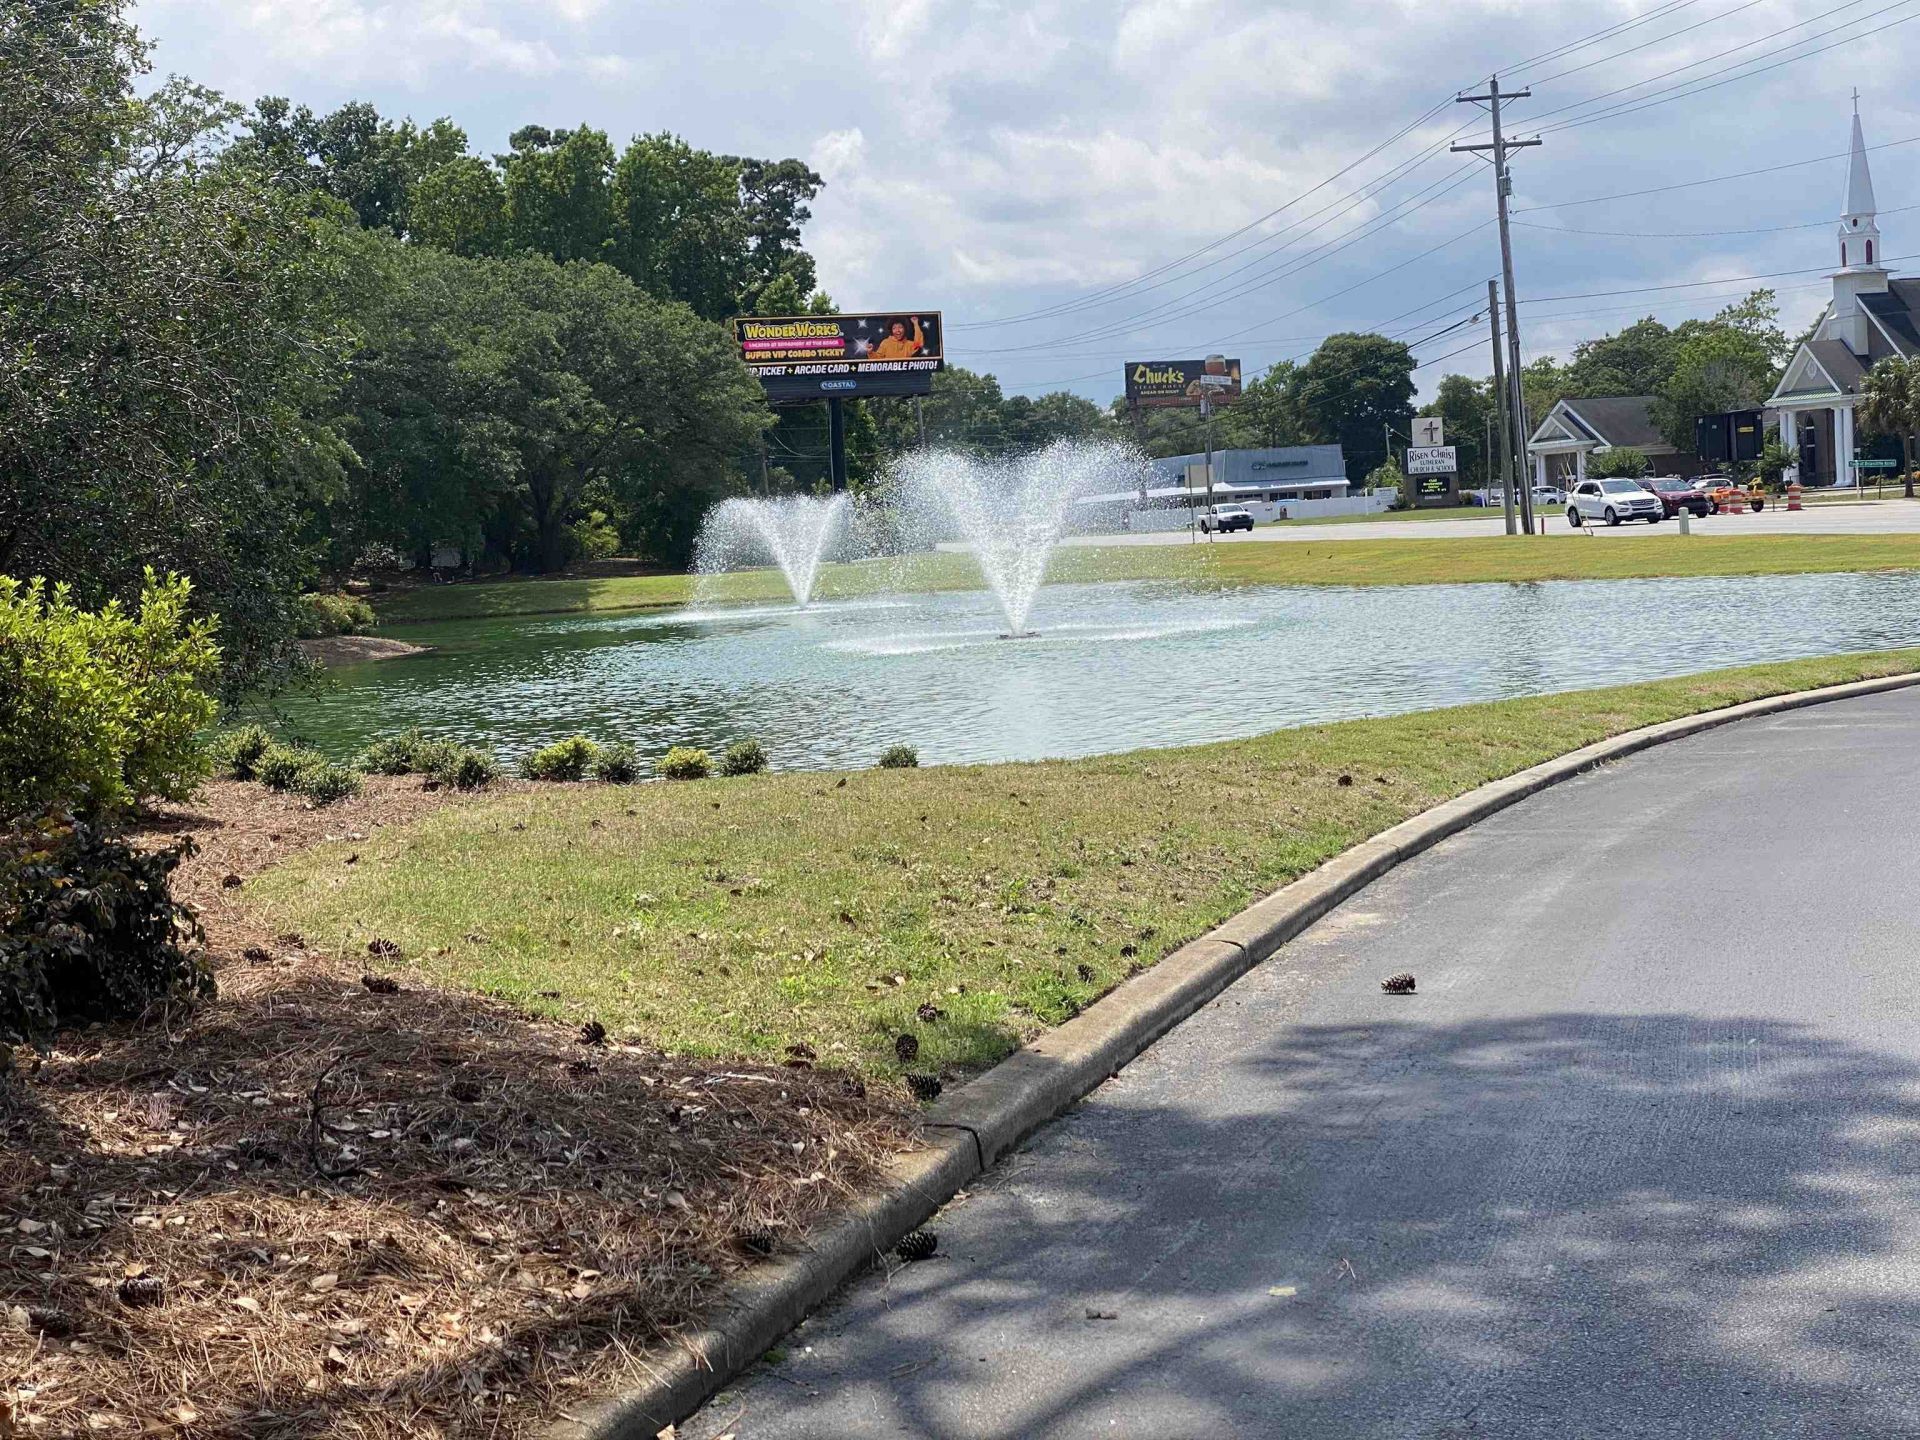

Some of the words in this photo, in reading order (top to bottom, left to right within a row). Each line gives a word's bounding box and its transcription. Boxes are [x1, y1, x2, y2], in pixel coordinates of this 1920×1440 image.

[745, 351, 771, 359] SUPER
[772, 350, 787, 359] VIP
[787, 349, 817, 358] COMBO
[817, 348, 845, 357] TICKET
[759, 366, 787, 376] TICKET
[794, 365, 827, 375] ARCADE
[828, 364, 849, 373] CARD
[857, 362, 908, 373] MEMORABLE
[908, 361, 937, 370] PHOTO!
[1134, 365, 1184, 384] Chuck's
[822, 381, 855, 389] COASTAL
